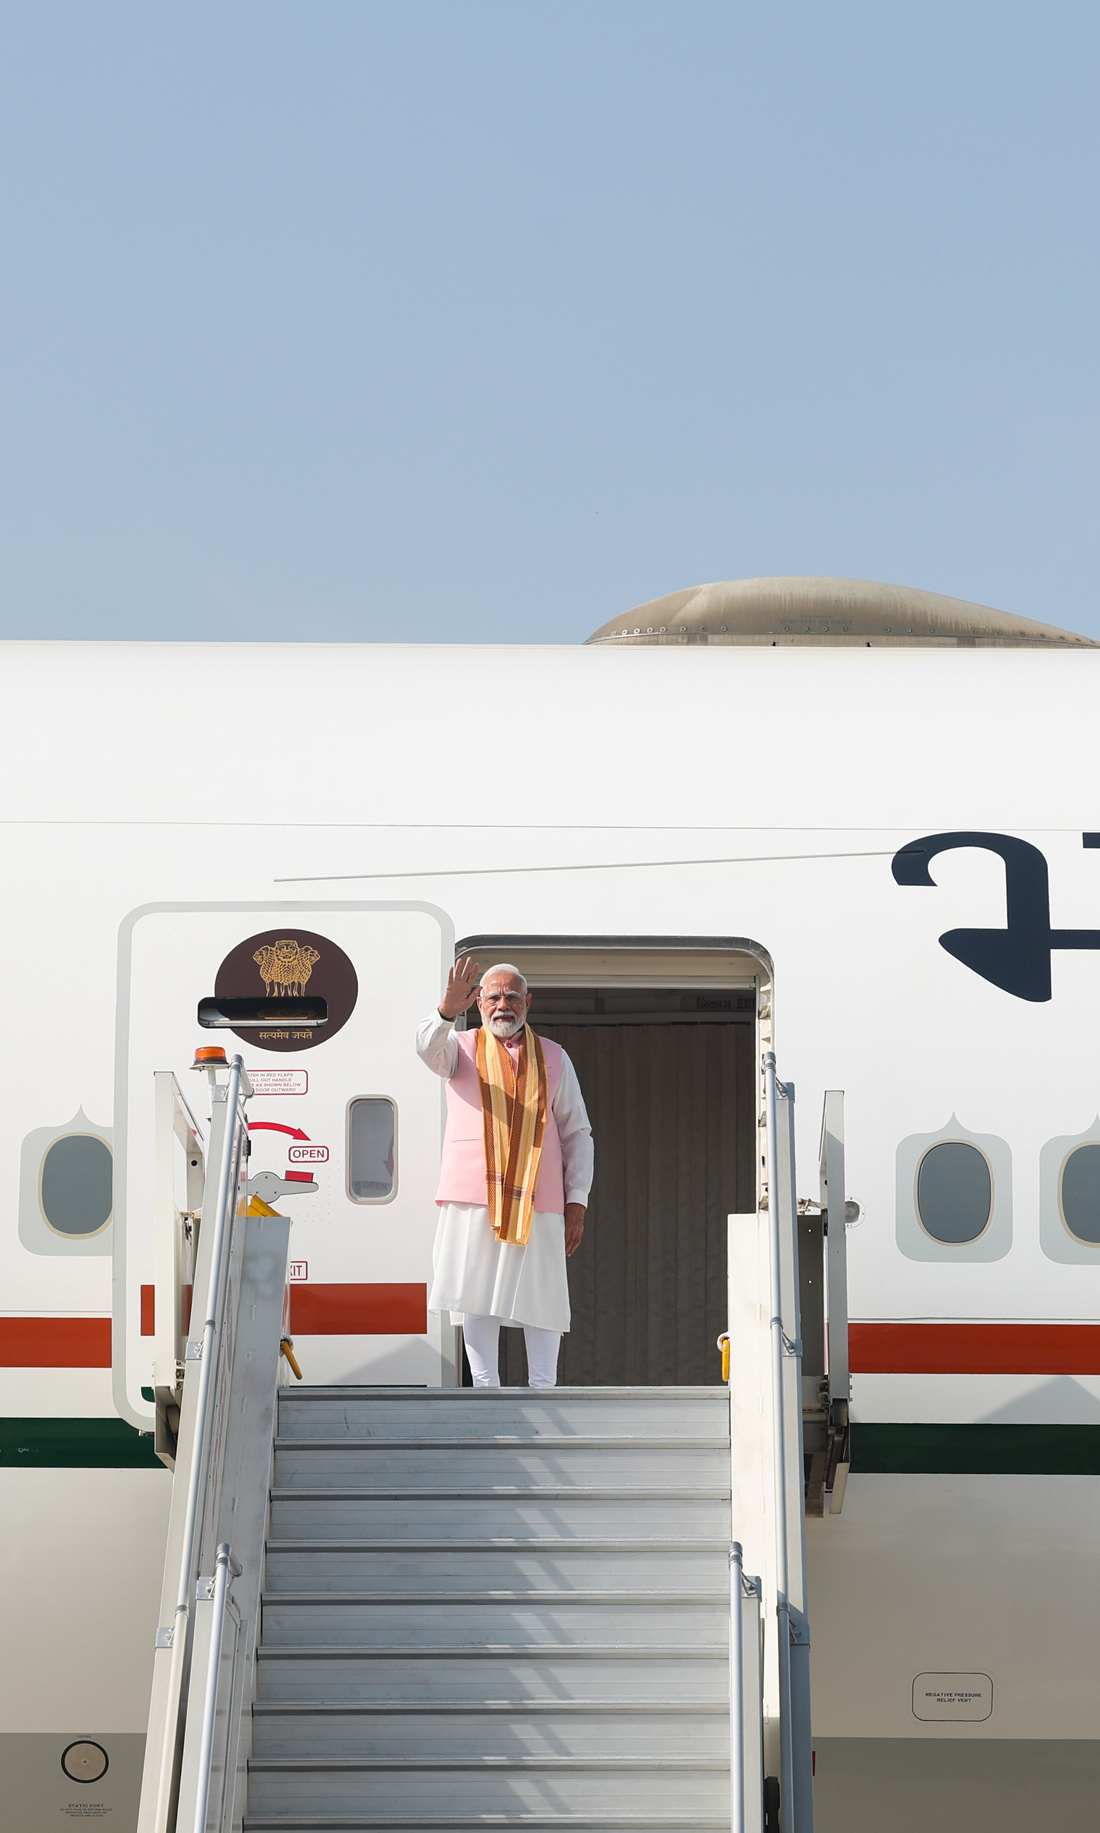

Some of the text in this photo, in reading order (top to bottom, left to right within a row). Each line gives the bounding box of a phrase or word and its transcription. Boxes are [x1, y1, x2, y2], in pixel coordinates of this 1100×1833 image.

[259, 1029, 313, 1040] सत्यमेव जयते
[293, 1149, 325, 1158] OPEN
[362, 1180, 388, 1190] OPEN
